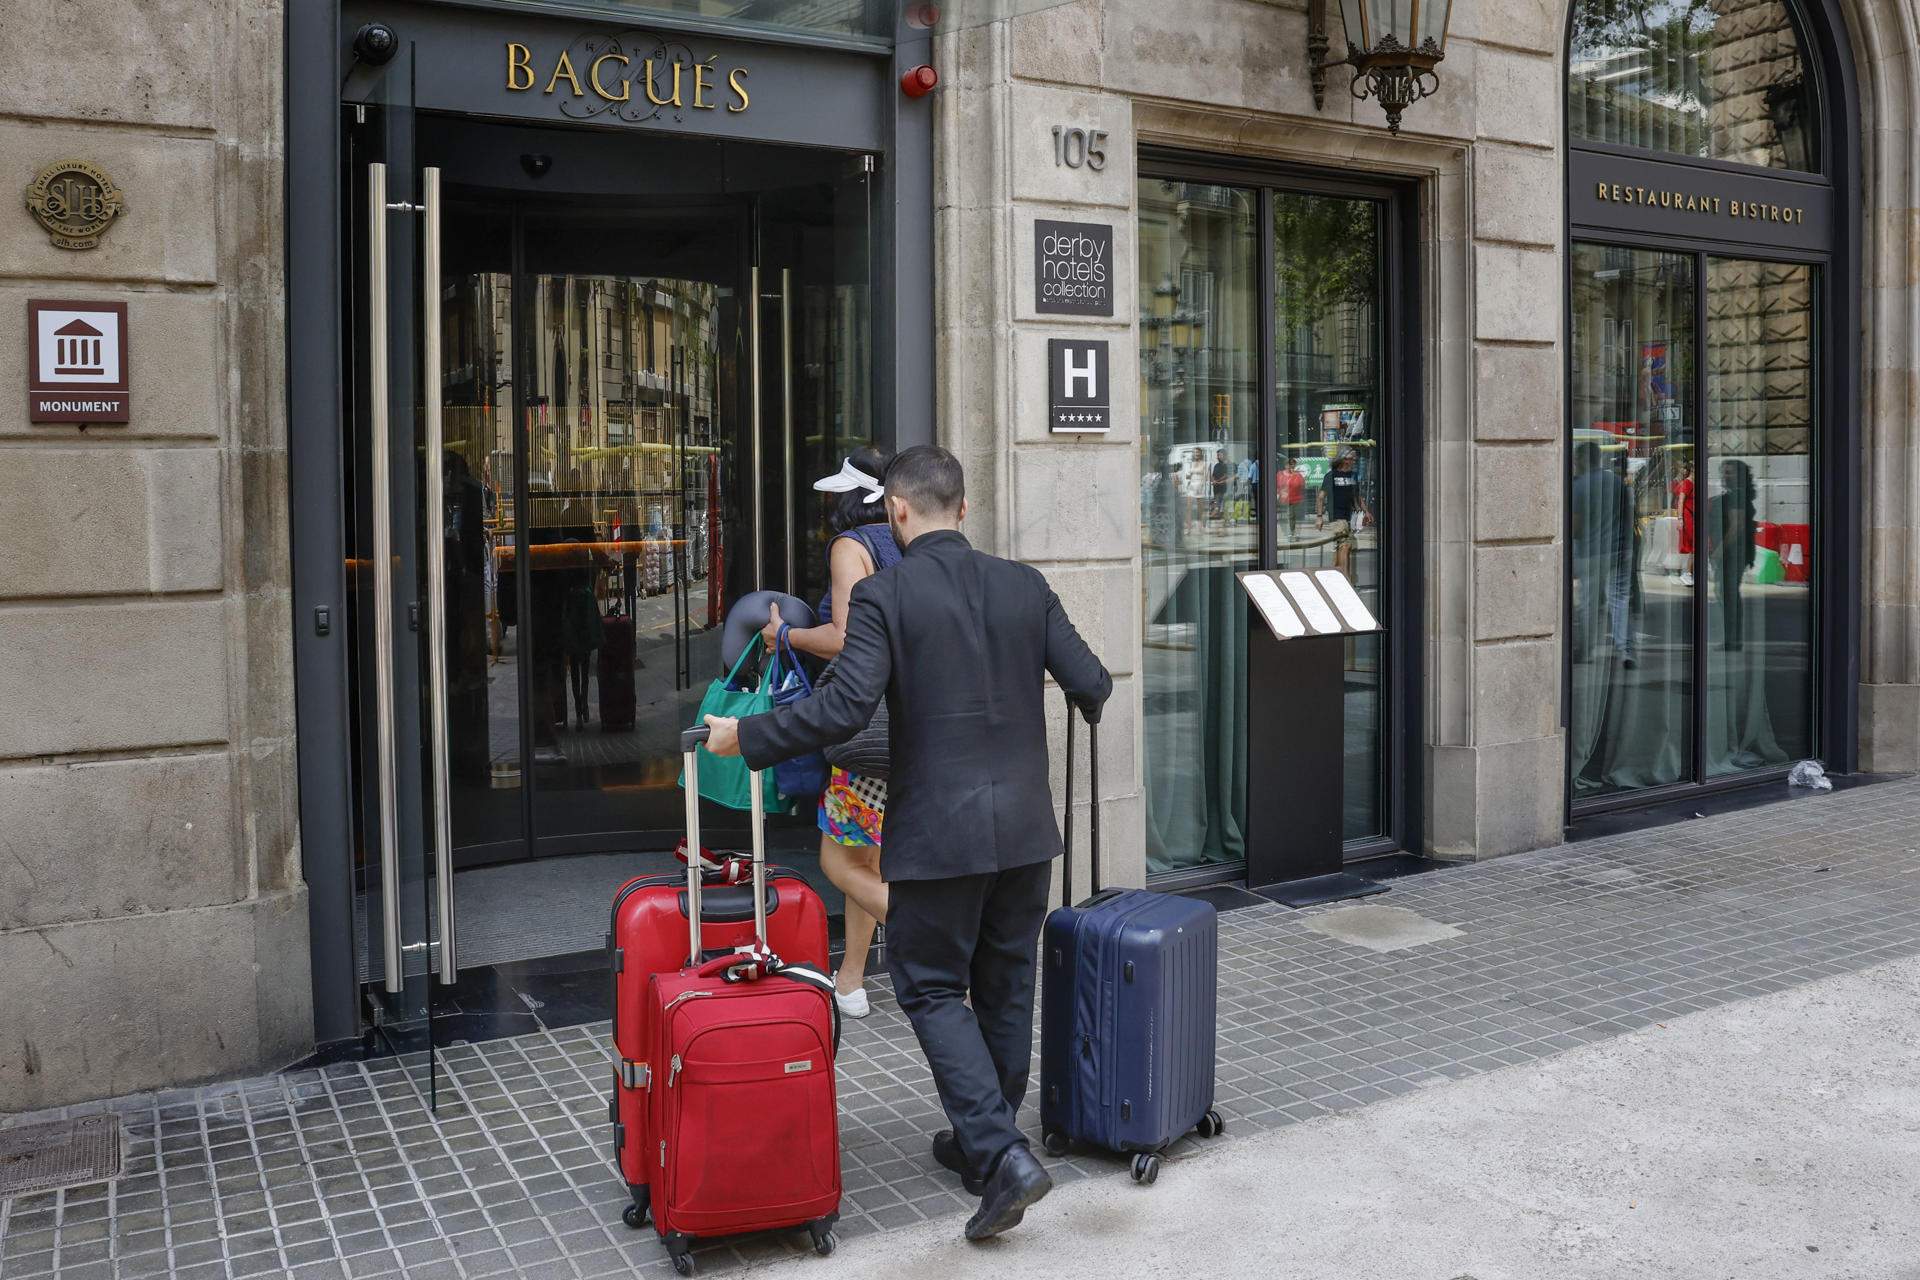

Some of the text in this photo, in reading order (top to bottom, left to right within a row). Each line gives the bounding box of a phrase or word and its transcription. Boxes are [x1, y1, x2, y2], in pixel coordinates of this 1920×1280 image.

[505, 41, 750, 114] BAGUÉS
[1051, 125, 1109, 172] 105
[1597, 182, 1804, 225] RESTAURANT BISTROT
[56, 238, 94, 247] slh.com
[1043, 230, 1106, 263] derby
[1043, 254, 1106, 282] hotels
[1043, 281, 1106, 298] collection
[1064, 348, 1097, 398] H
[40, 401, 120, 412] MONUMENT
